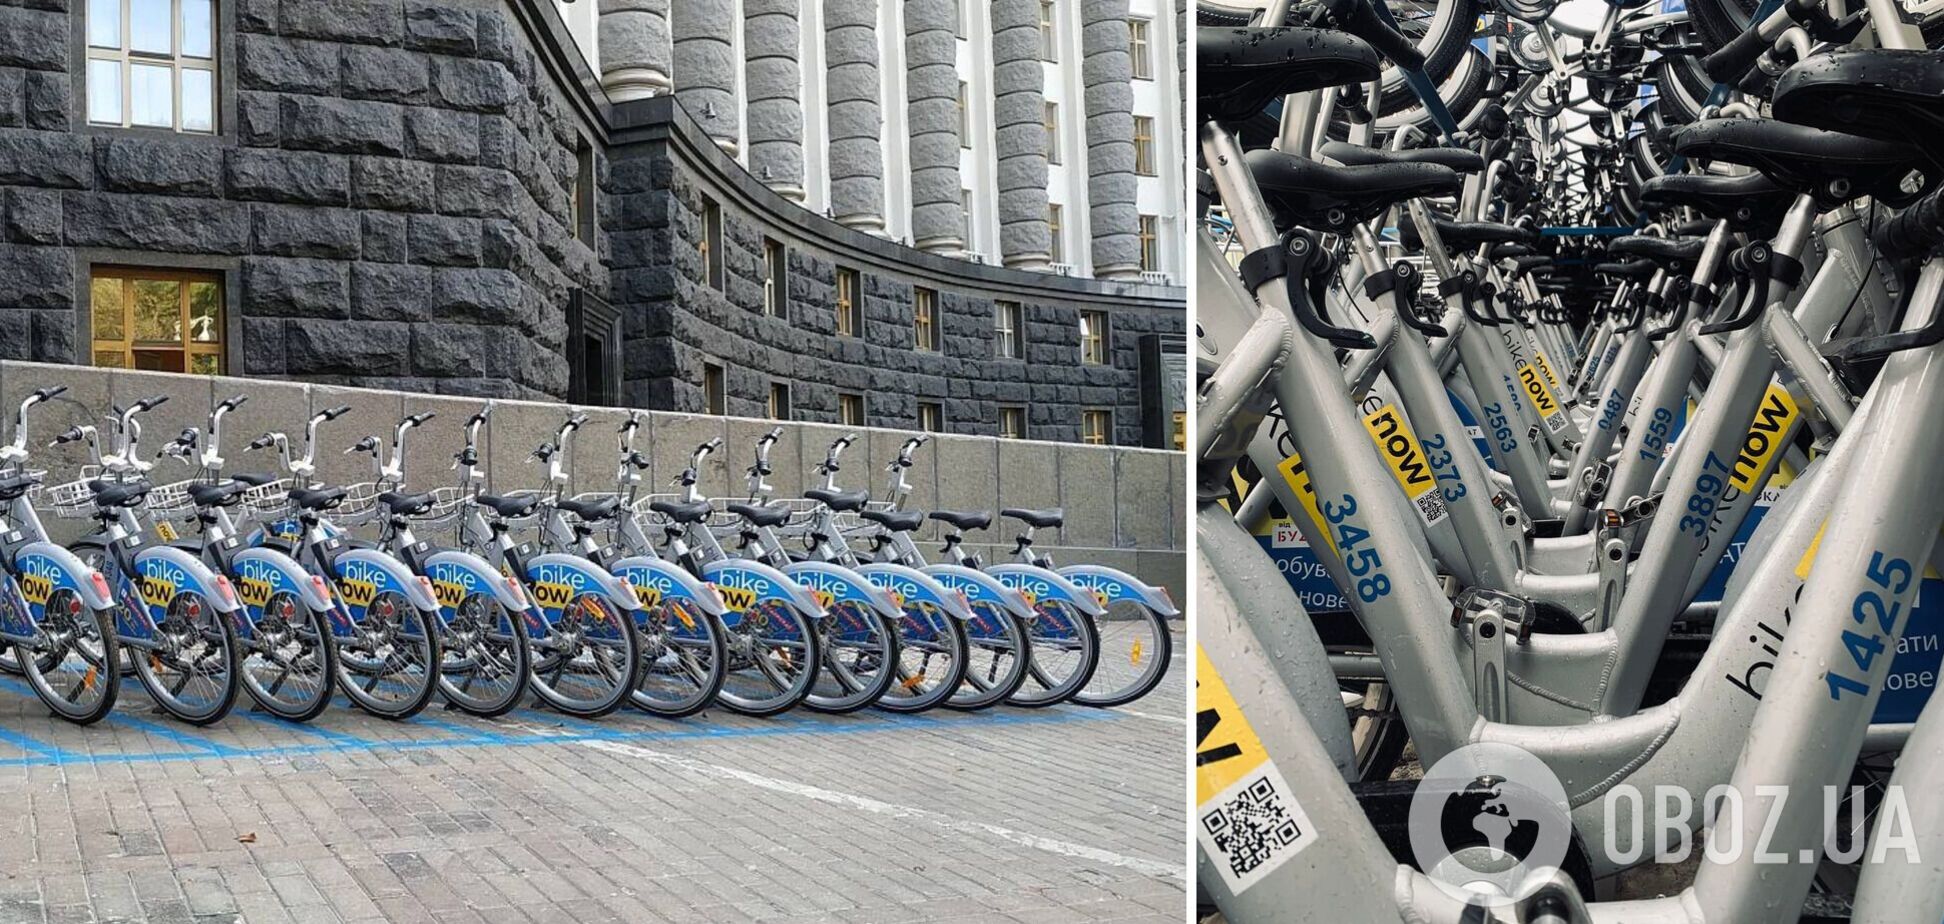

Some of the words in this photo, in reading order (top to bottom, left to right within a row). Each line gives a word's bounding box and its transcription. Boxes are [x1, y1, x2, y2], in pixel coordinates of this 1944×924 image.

[1520, 368, 1554, 410] now
[1598, 388, 1625, 430] 0487
[1484, 402, 1517, 452] 2563
[1640, 407, 1672, 460] 1559
[1732, 394, 1790, 484] now
[1372, 411, 1431, 486] now
[1421, 434, 1467, 502] 2373
[1679, 450, 1729, 538] 3897
[1325, 494, 1391, 603] 3458
[26, 557, 61, 585] bike
[147, 561, 185, 588] bike
[244, 562, 281, 588] bike
[346, 562, 386, 588] bike
[437, 565, 476, 590] bike
[540, 566, 585, 590] bike
[627, 569, 672, 594] bike
[720, 571, 769, 595] bike
[24, 579, 49, 600] ow
[144, 581, 171, 602] ow
[241, 583, 269, 602] ow
[342, 582, 372, 601] ow
[434, 584, 462, 604] ow
[536, 587, 569, 605] ow
[1825, 550, 1913, 701] 1425
